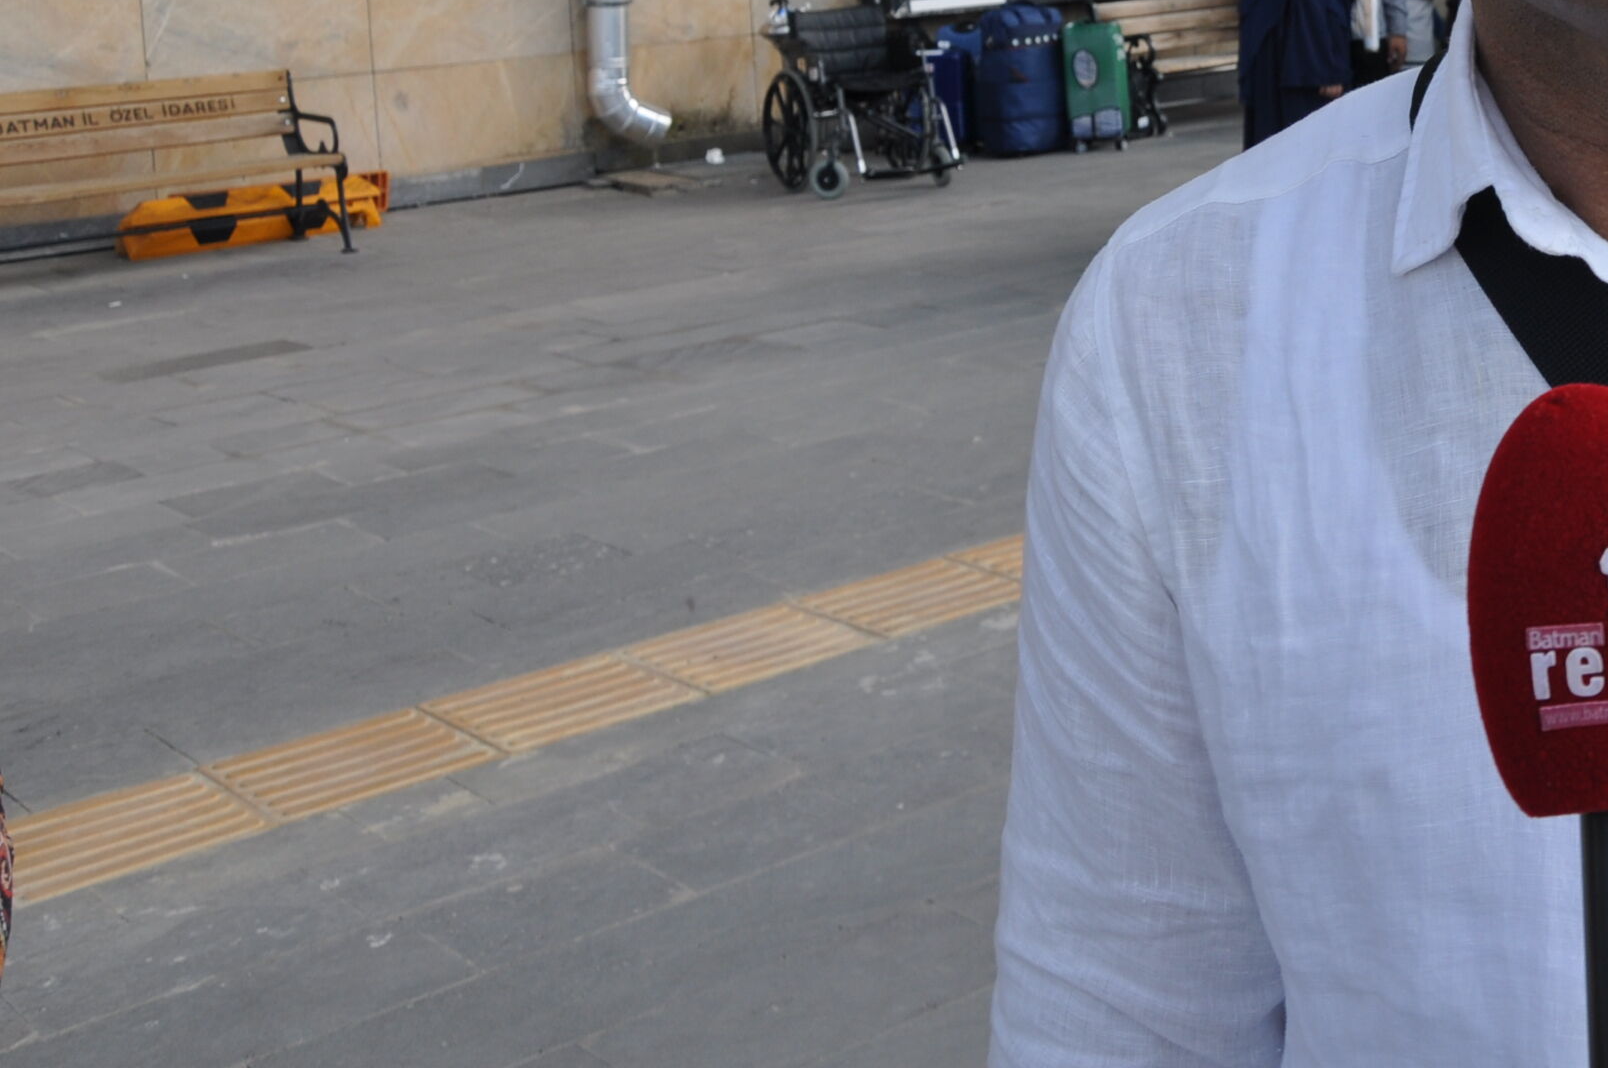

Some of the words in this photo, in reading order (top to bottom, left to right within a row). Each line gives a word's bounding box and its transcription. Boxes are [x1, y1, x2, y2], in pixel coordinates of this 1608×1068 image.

[82, 111, 98, 126] İL
[109, 106, 153, 124] ÖZEL
[162, 97, 236, 117] İDARESİ
[1529, 629, 1603, 650] Batman
